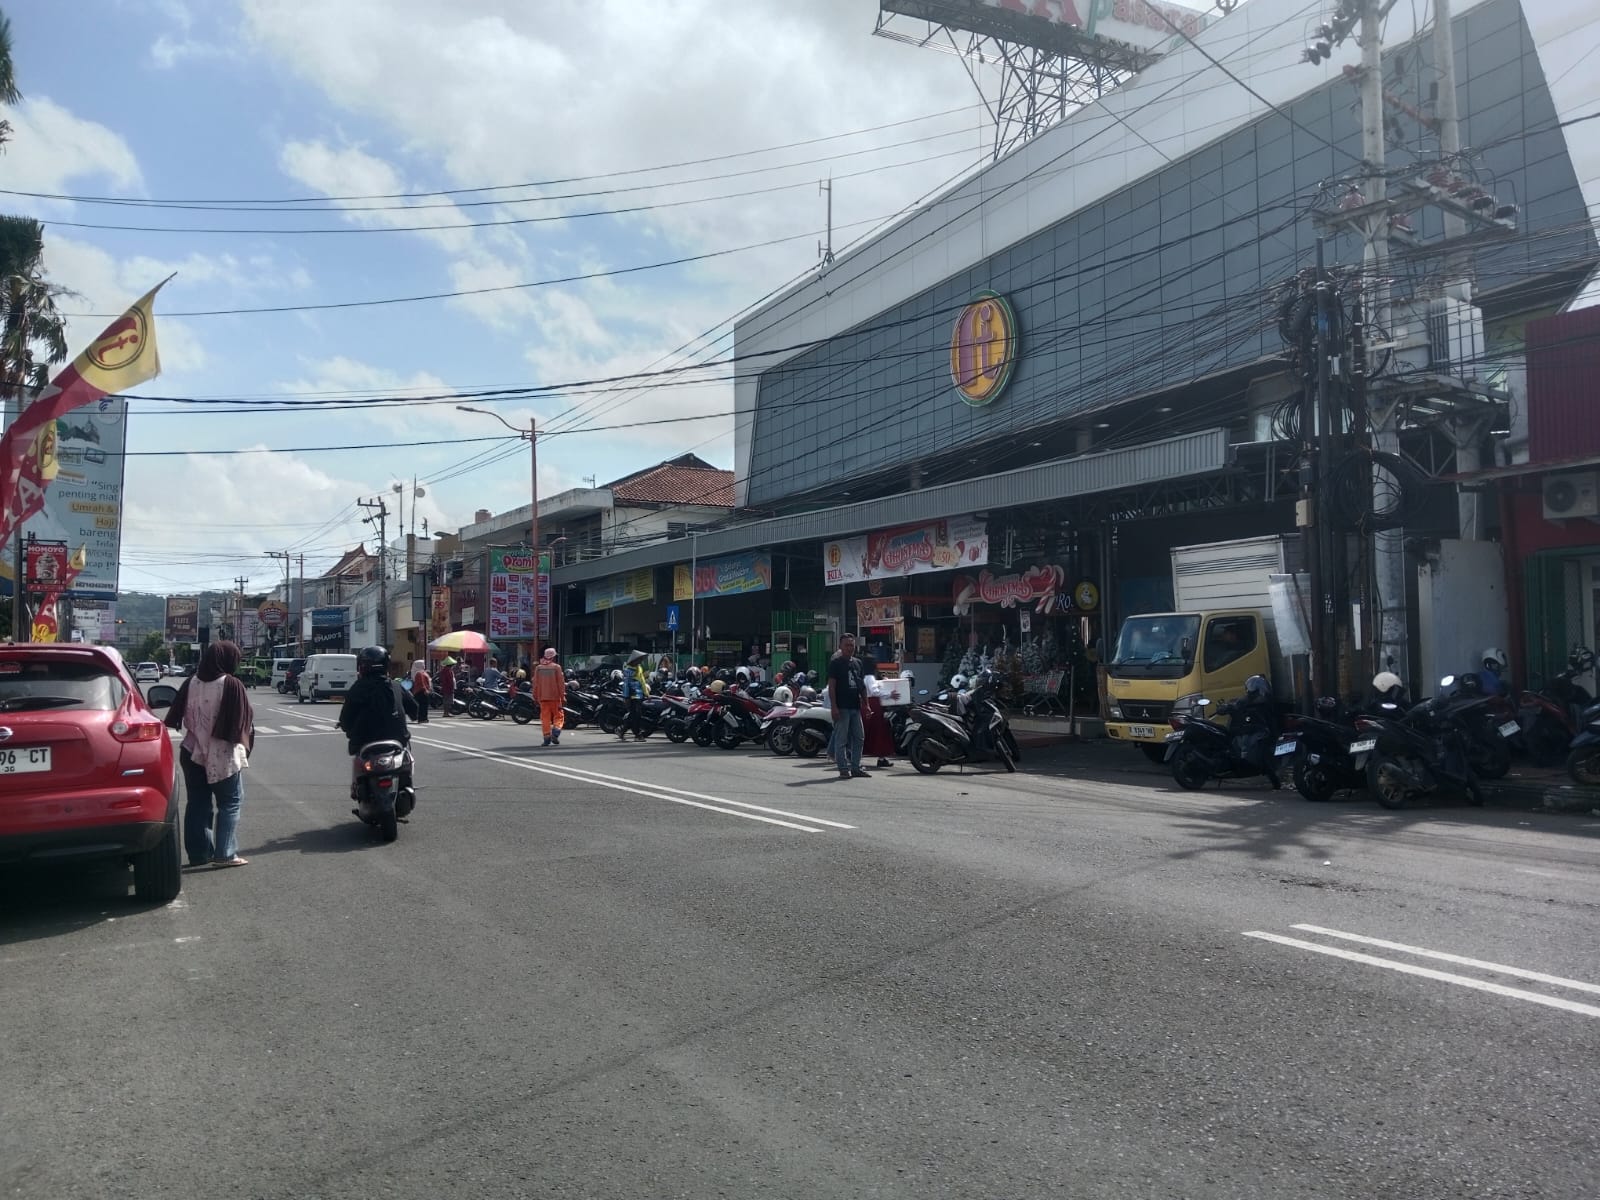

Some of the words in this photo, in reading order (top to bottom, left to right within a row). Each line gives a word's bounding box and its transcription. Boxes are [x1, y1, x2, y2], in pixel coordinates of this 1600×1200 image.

[58, 489, 97, 501] penting
[99, 491, 118, 501] niat
[71, 503, 104, 512] Umrah
[95, 517, 115, 528] Haji
[79, 527, 117, 540] bareng
[27, 545, 65, 553] MOMOYO
[826, 569, 843, 580] RITA
[29, 749, 48, 763] CT
